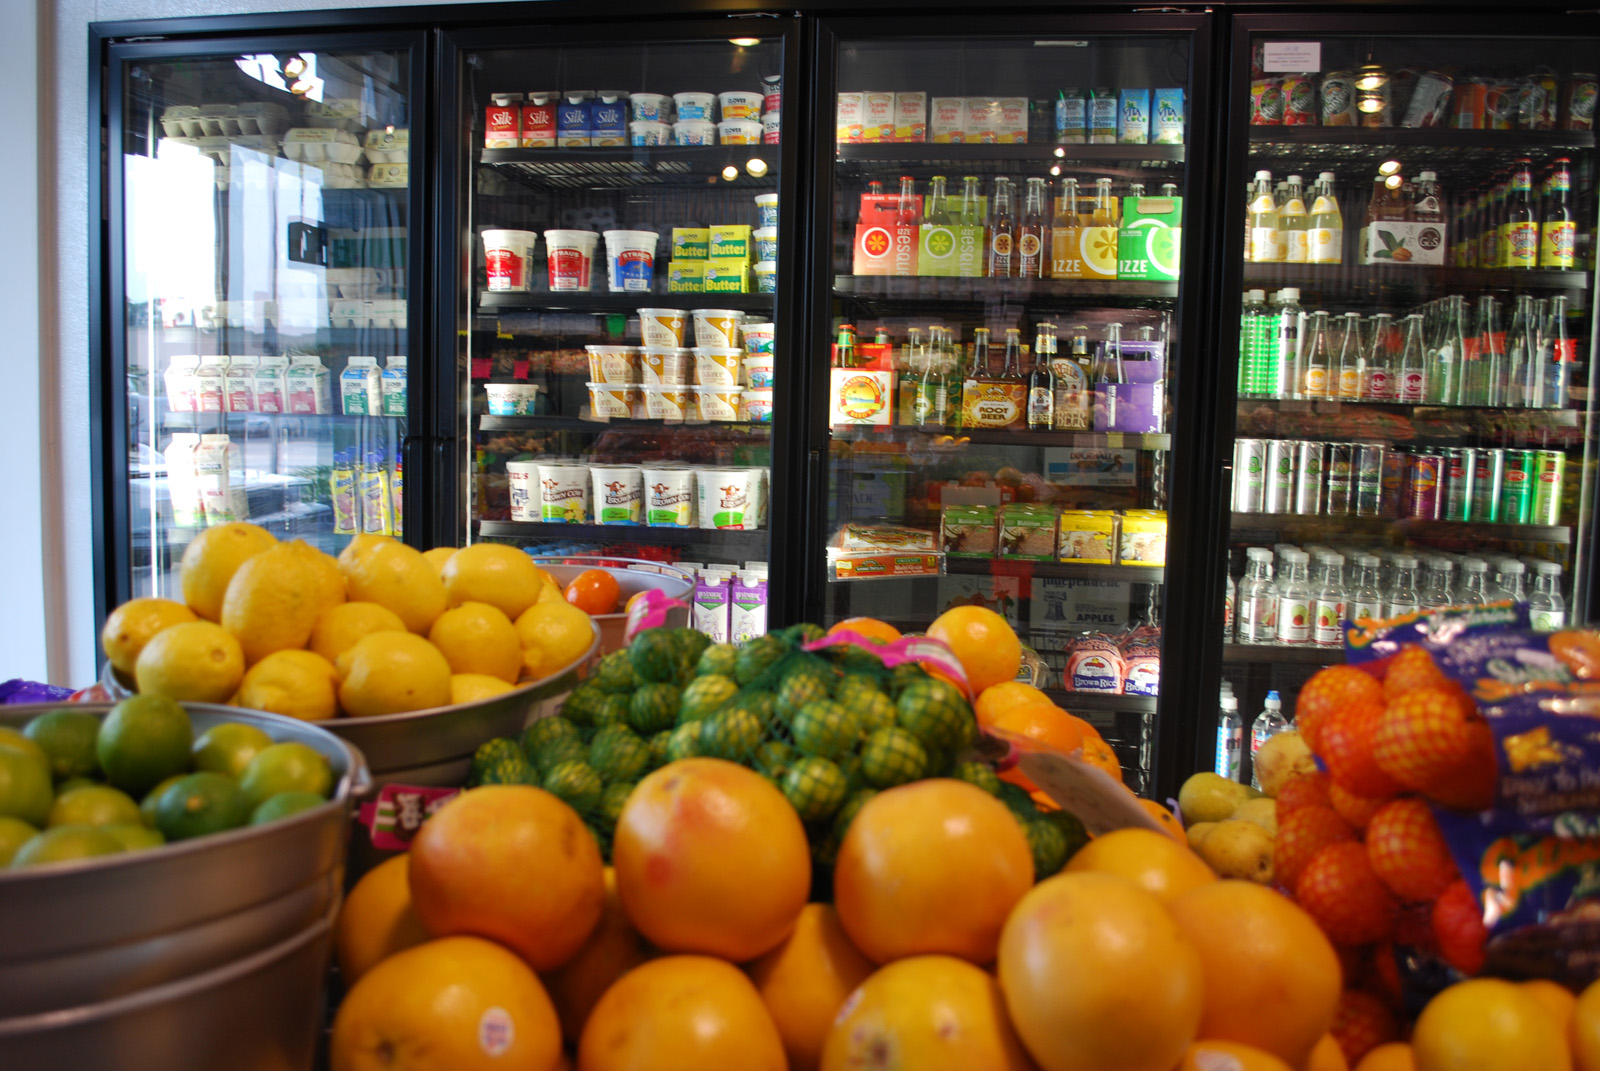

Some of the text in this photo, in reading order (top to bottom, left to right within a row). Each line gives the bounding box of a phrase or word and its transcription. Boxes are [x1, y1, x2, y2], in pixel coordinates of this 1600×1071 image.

[528, 111, 550, 125] Silk
[564, 110, 584, 124] Silk
[597, 110, 618, 124] Silk
[1122, 108, 1142, 117] VITA
[1157, 108, 1177, 117] VITA
[491, 112, 512, 126] Silk
[674, 246, 708, 256] Butter
[712, 244, 745, 255] Butter
[623, 252, 650, 260] STRAUS
[1054, 260, 1080, 272] IZZE
[1120, 260, 1148, 273] IZZE
[706, 280, 740, 291] Butter
[1056, 411, 1087, 428] BEER
[544, 489, 584, 502] BROWN COW
[607, 495, 632, 504] BROWN
[652, 497, 679, 506] BROWN
[1076, 614, 1114, 622] APPLES
[1074, 677, 1117, 688] Brown Rice
[1126, 682, 1152, 693] Brown
